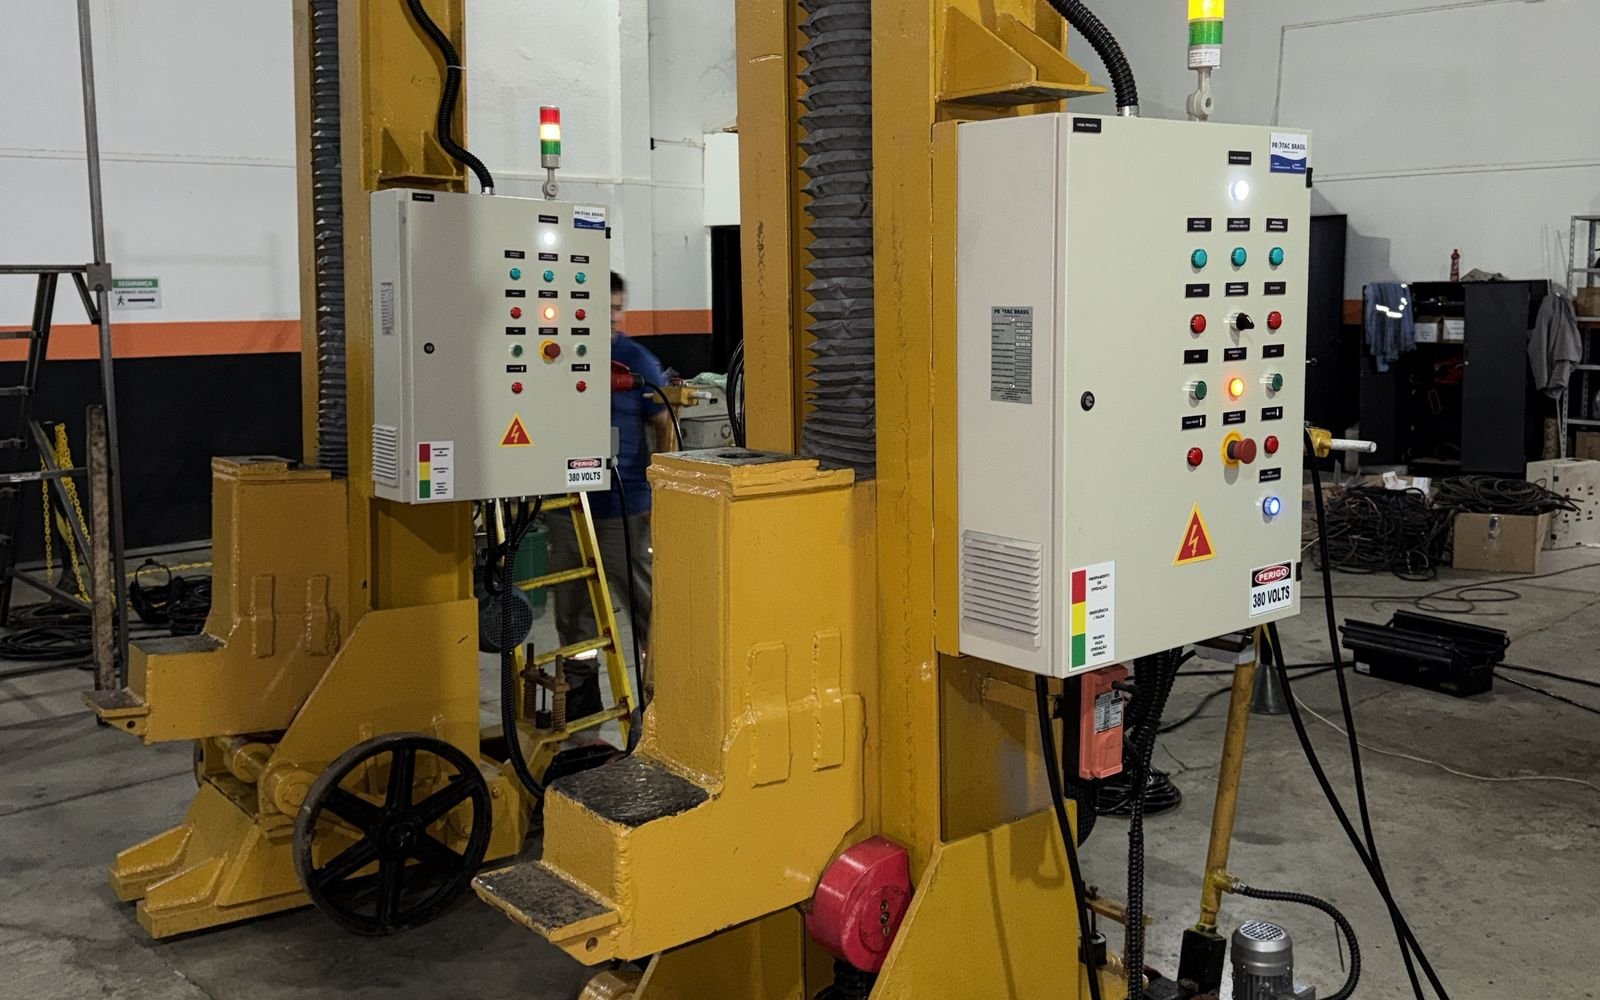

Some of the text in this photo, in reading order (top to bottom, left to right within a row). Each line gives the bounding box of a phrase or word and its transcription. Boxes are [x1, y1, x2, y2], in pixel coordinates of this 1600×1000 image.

[569, 472, 600, 482] 380 VOLTS
[1258, 568, 1286, 582] PERIGO
[1253, 586, 1289, 608] 380 VOLTS
